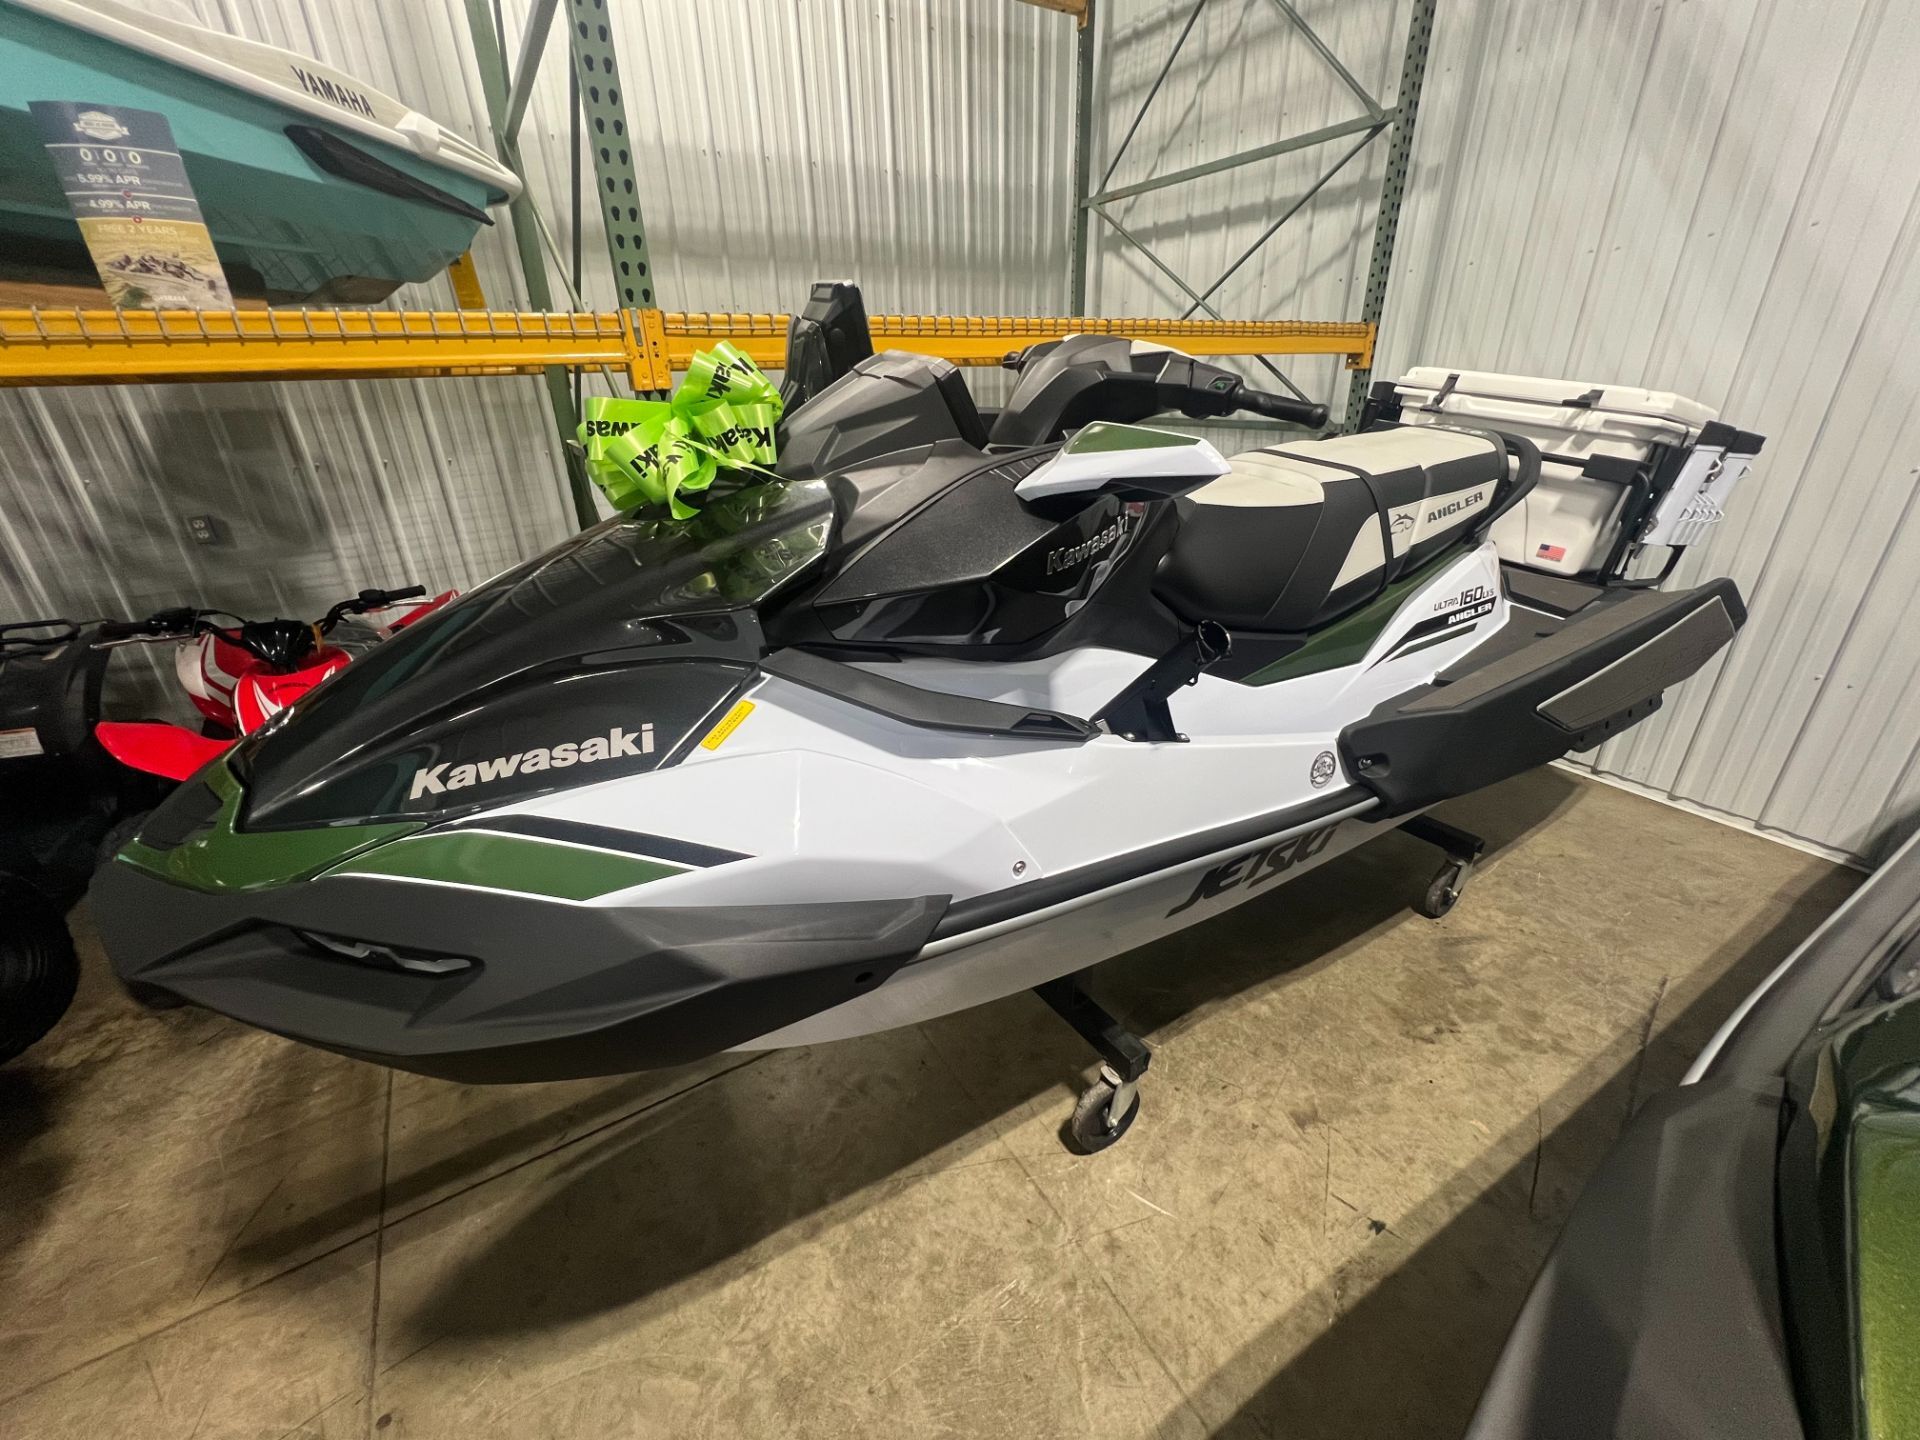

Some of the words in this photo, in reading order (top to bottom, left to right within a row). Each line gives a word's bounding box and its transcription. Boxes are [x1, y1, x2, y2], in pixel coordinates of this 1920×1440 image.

[290, 65, 376, 119] YAMAHA
[116, 174, 141, 185] APR
[126, 200, 151, 210] APR
[137, 225, 177, 235] YEARS
[1427, 491, 1484, 524] ANGLER
[1046, 510, 1129, 576] Kawasaki
[1433, 596, 1459, 612] ULTRA
[1447, 602, 1493, 625] ANGLER
[409, 723, 655, 801] Kawasaki
